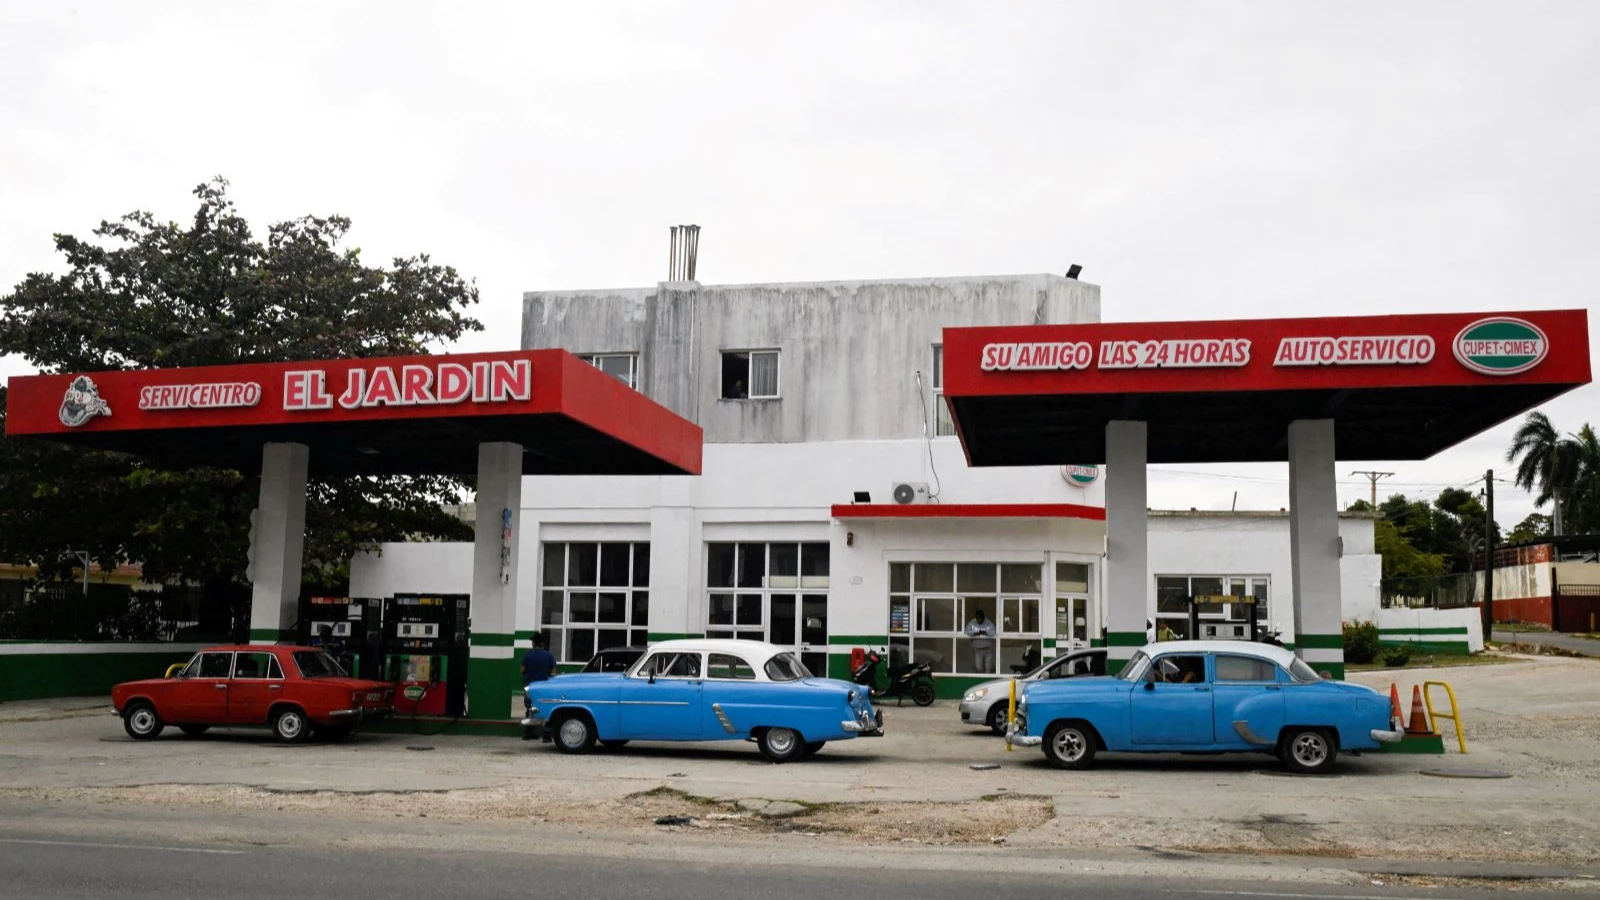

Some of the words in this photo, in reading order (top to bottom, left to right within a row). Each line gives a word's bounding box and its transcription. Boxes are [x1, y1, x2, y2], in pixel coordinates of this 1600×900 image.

[984, 345, 1013, 368] SU
[1016, 343, 1090, 367] AMIGO
[1100, 342, 1138, 366] LAS
[1143, 342, 1169, 365] 24
[1173, 340, 1249, 364] HORAS
[1277, 337, 1432, 362] AUTOSERVICIO
[1462, 339, 1538, 355] CUPET-CIMEX
[139, 382, 260, 409] SERVICENTRO
[284, 370, 333, 410] EL
[338, 360, 530, 409] JARDIN
